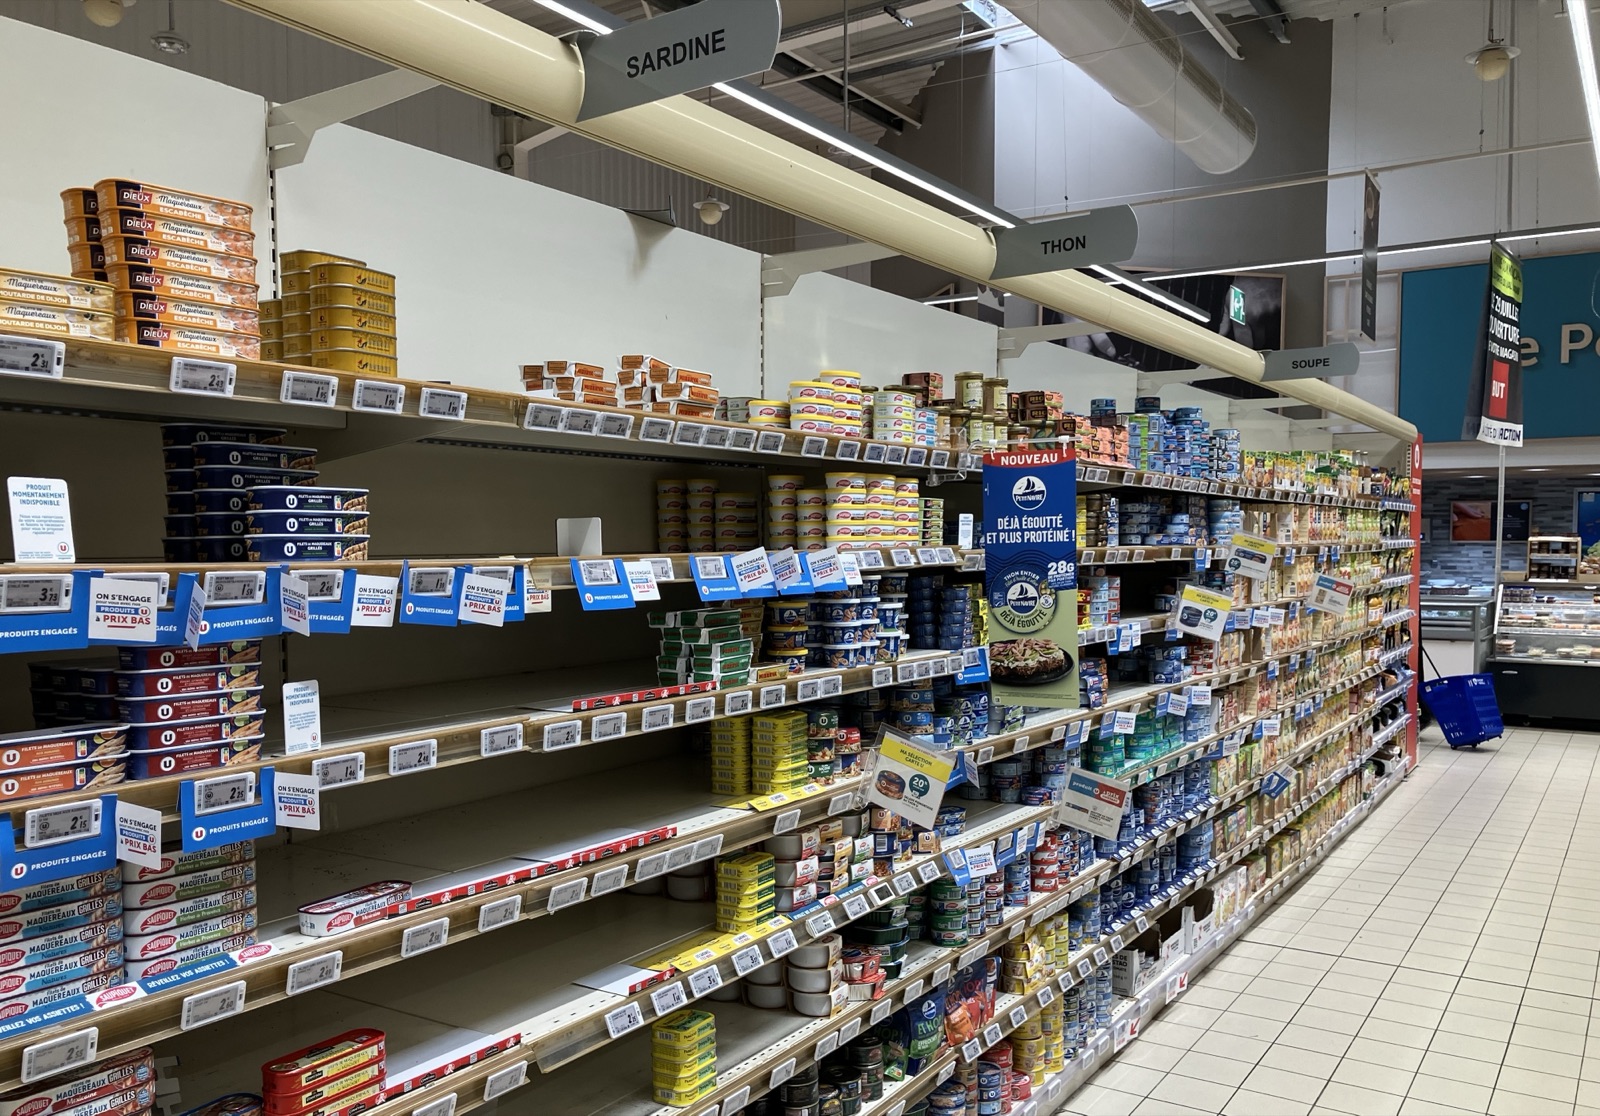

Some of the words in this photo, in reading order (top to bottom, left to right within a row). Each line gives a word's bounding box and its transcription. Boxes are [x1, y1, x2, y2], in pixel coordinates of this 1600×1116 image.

[626, 28, 726, 79] SARDINE
[123, 191, 150, 203] DIEUX
[158, 195, 203, 211] Maquereaux
[126, 219, 153, 231] DIEUX
[161, 222, 205, 236] Maquereaux
[131, 247, 157, 257] DIEUX
[1041, 235, 1087, 256] THON
[165, 249, 208, 263] Maquereaux
[6, 278, 58, 292] Maquereaux
[136, 275, 162, 285] DIEUX
[170, 277, 212, 290] Maquereaux
[46, 295, 68, 304] DIJON
[5, 306, 57, 320] Maquereaux
[140, 302, 165, 312] DIEUX
[173, 303, 214, 317] Maquereaux
[0, 319, 35, 328] OUTARDE
[45, 322, 67, 331] DIJON
[143, 329, 169, 339] DIEUX
[177, 330, 217, 343] Maquereaux
[1560, 323, 1600, 364] P
[1291, 357, 1331, 370] SOUPE
[1000, 453, 1058, 466] NOUVEAU
[12, 491, 65, 499] MOMENTANEMENT
[997, 515, 1020, 529] DÉJÀ
[1022, 514, 1063, 529] ÉGOUTTÉ
[986, 532, 997, 544] ET
[999, 532, 1022, 543] PLUS
[1024, 528, 1069, 543] PROTÉINÉ
[1071, 529, 1075, 541] !
[743, 571, 757, 580] PRIX
[757, 567, 768, 578] BAS
[1047, 560, 1074, 575] 28G
[1020, 570, 1040, 580] ENTIER
[368, 587, 394, 595] S'ENGAGE
[476, 586, 503, 596] S'ENGAGE
[111, 594, 152, 603] S'ENGAGE
[100, 606, 135, 614] PRODUITS
[286, 606, 297, 617] PRIX
[297, 610, 307, 620] BAS
[361, 605, 377, 613] PRIX
[378, 605, 391, 613] BAS
[469, 601, 486, 611] PRIX
[487, 604, 502, 613] BAS
[103, 615, 128, 624] PRIX
[131, 616, 151, 625] BAS
[213, 620, 244, 629] PRODUITS
[244, 616, 274, 625] ENGAGÉS
[1016, 609, 1048, 628] ÉGOUTTÉ
[0, 629, 39, 638] PRODUITS
[40, 627, 78, 636] ENGAGÉS
[287, 786, 315, 794] S'ENGAGE
[283, 805, 300, 813] PRIX
[301, 807, 316, 815] BAS
[129, 818, 157, 832] S'ENGAGE
[209, 823, 240, 834] PRODUITS
[241, 816, 269, 828] ENGAGÉS
[122, 829, 146, 841] PRODUITS
[124, 839, 141, 850] PRIX
[142, 843, 157, 853] BAS
[31, 857, 70, 871] PRODUITS
[71, 850, 107, 863] ENGAGÉS
[178, 851, 219, 863] MAQUEREAUX
[179, 875, 220, 889] MAQUEREAUX
[25, 883, 75, 900] MAQUEREAUX
[146, 885, 173, 898] SAUPIQUET
[180, 899, 220, 914] MAQUEREAUX
[26, 909, 76, 927] MAQUEREAUX
[147, 911, 174, 924] SAUPIQUET
[180, 924, 220, 940] MAQUEREAUX
[202, 933, 221, 942] Provence
[29, 936, 78, 954] MAQUEREAUX
[146, 938, 174, 951] SAUPIQUET
[180, 947, 221, 964] MAQUEREAUX
[29, 961, 78, 980] MAQUEREAUX
[147, 962, 175, 975] SAUPIQUET
[147, 973, 181, 989] RÉVEILLEZ
[180, 969, 194, 978] VOS
[195, 960, 226, 974] ASSIETTES
[32, 987, 80, 1007] MAQUEREAUX
[100, 987, 135, 1002] SAUPIQUET
[26, 1017, 42, 1025] VOS
[43, 1004, 79, 1020] ASSIETTES
[56, 1079, 106, 1101] MAQUEREAUX
[66, 1091, 97, 1106] Mexicaine
[16, 1099, 49, 1116] SAUPIQUET
